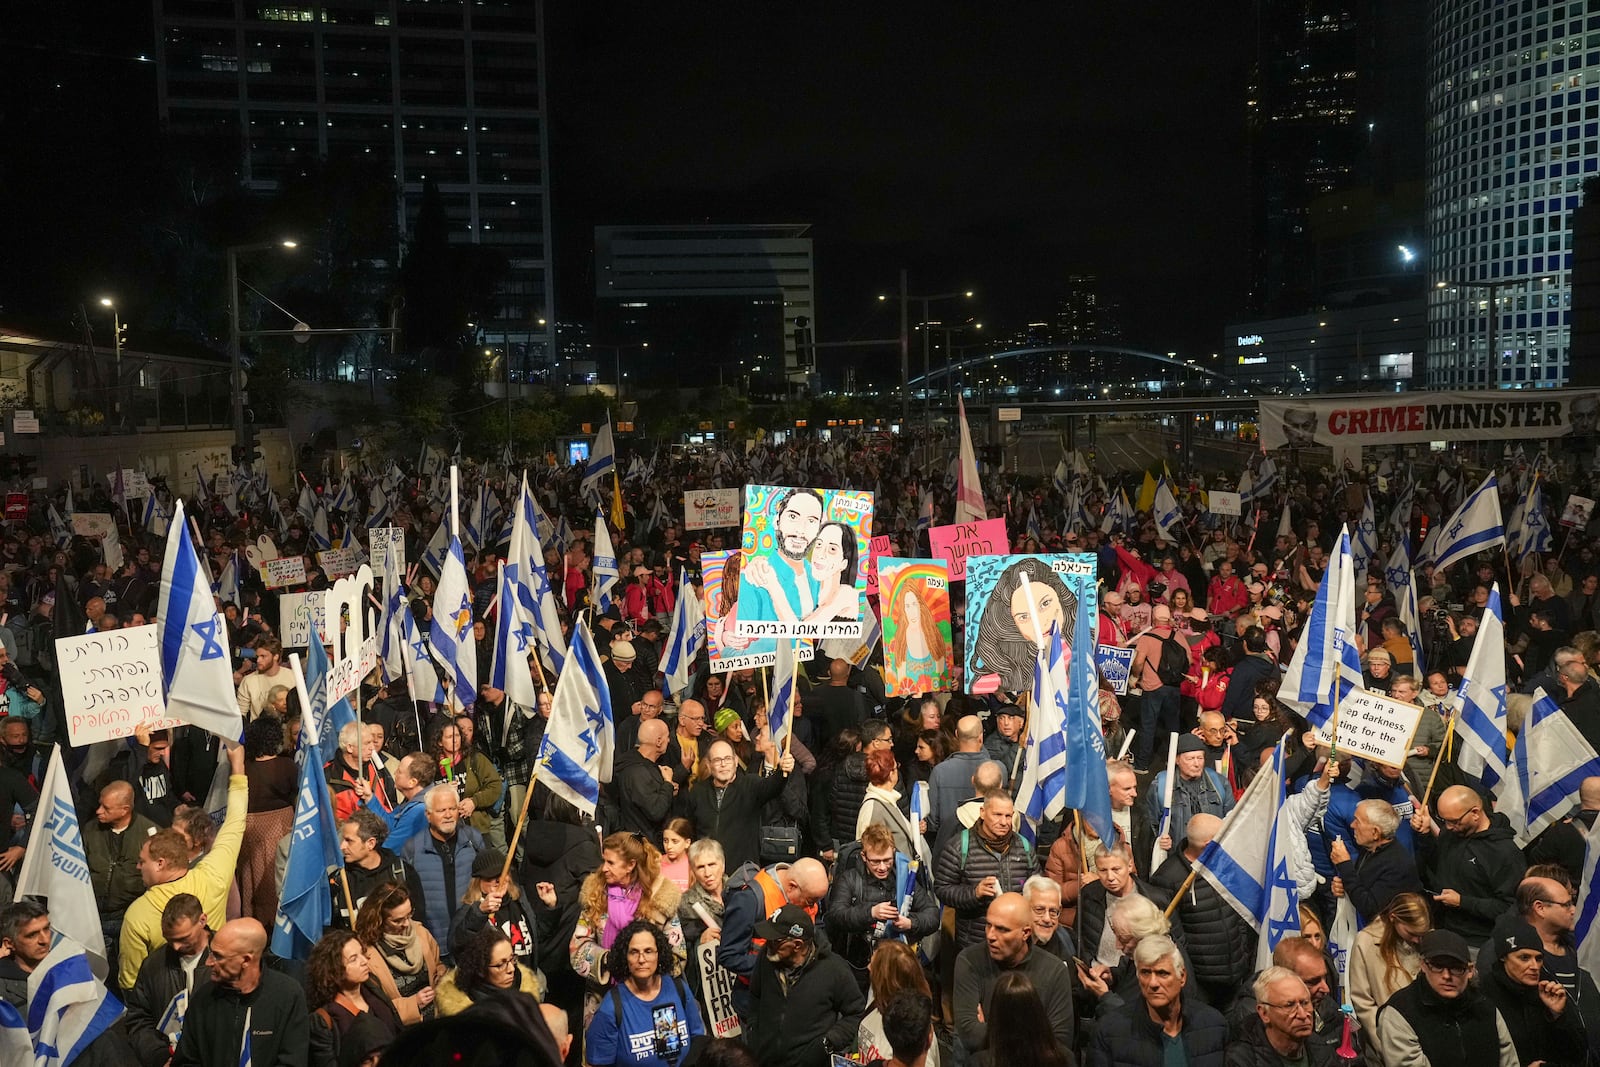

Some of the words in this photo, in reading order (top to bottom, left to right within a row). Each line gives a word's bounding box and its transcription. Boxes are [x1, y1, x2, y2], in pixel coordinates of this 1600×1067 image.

[953, 524, 978, 542] את
[1053, 562, 1091, 574] דניאלה
[928, 577, 945, 588] נעמה
[792, 624, 818, 635] אותו
[823, 624, 860, 635] החזירו
[65, 635, 129, 662] הוריתי
[82, 661, 149, 684] הפקרתי
[141, 704, 161, 720] את
[1374, 700, 1384, 711] in
[72, 708, 131, 736] החטופים
[1346, 707, 1359, 717] ep
[1362, 712, 1406, 734] darkness,
[108, 726, 135, 739] כשיו
[1339, 719, 1358, 734] ting
[1361, 727, 1376, 737] for
[1379, 732, 1396, 743] the
[1347, 737, 1357, 747] to
[1360, 742, 1386, 756] shine
[711, 994, 733, 1023] FR
[715, 1015, 741, 1034] NETAN
